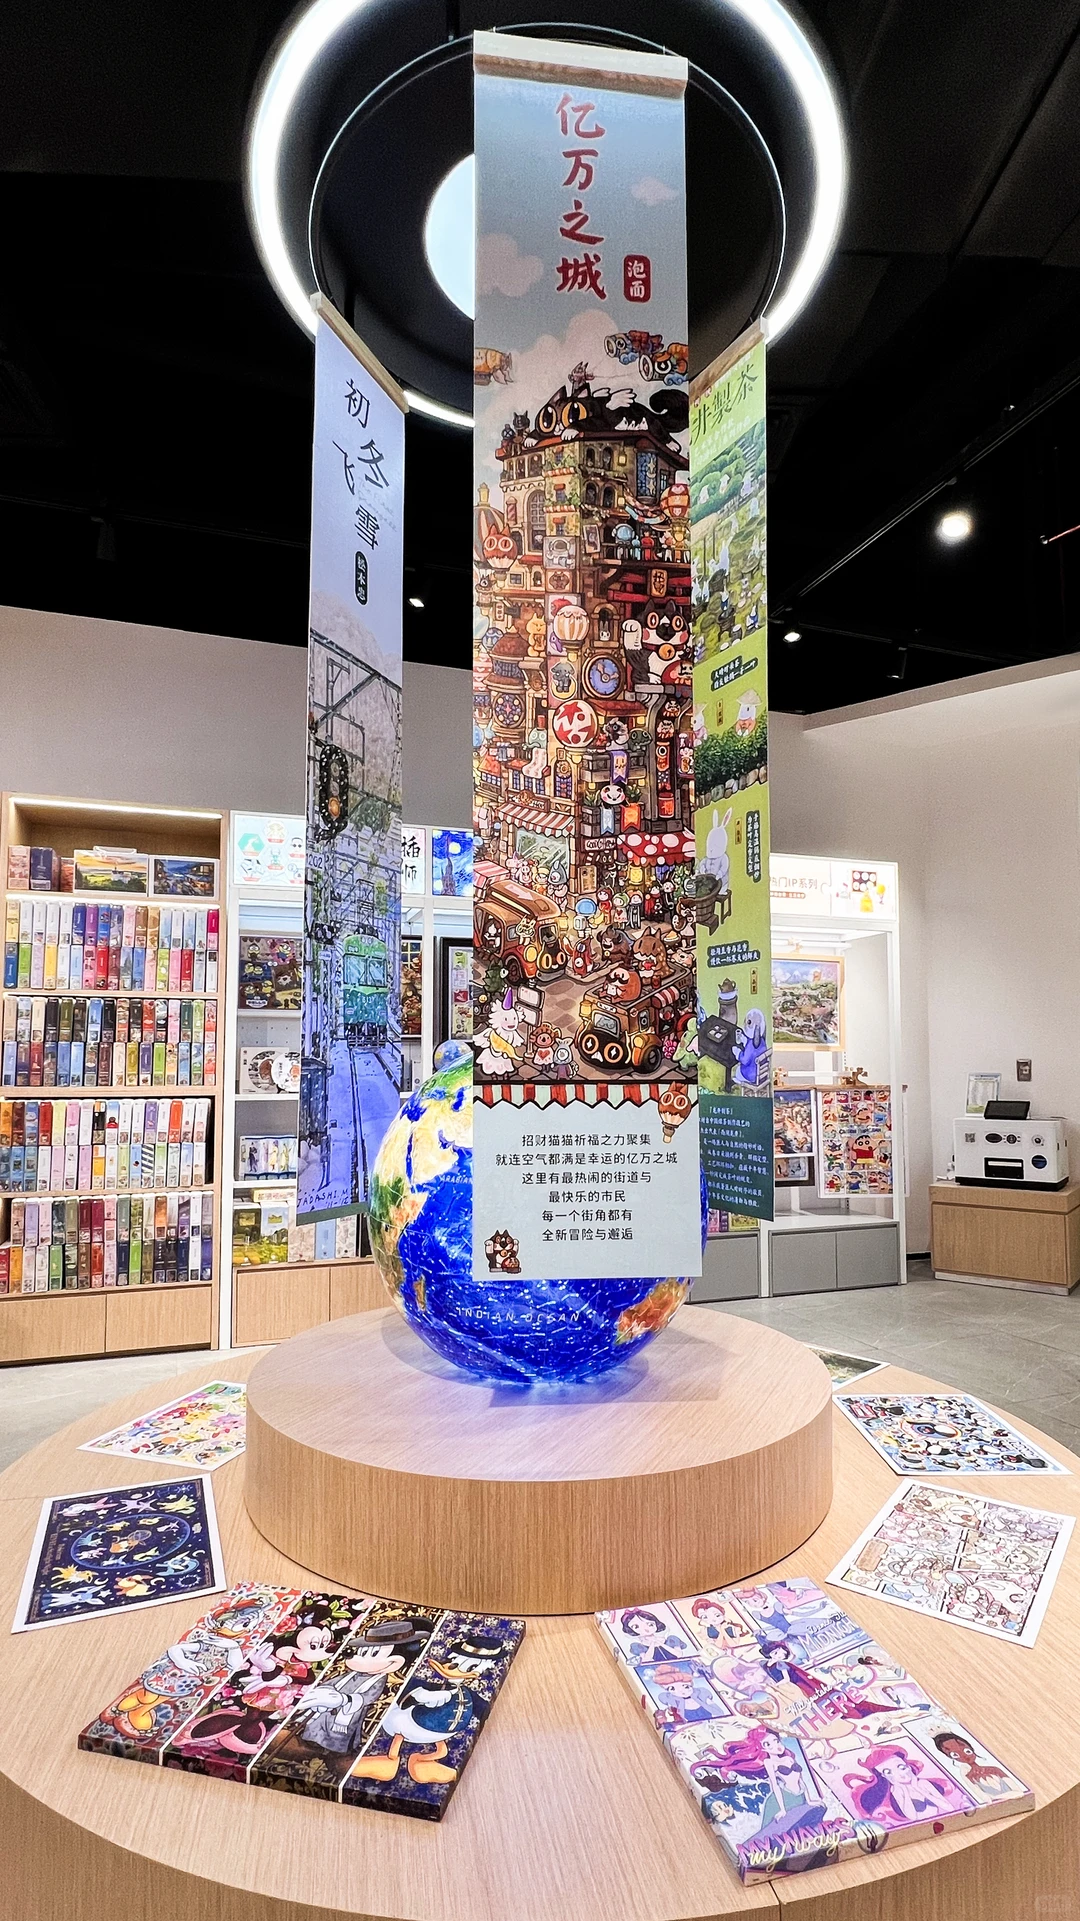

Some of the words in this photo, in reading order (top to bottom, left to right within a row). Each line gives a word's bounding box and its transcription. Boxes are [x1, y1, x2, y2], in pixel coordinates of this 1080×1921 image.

[555, 92, 607, 300] 亿万之城
[627, 259, 647, 299] 泡面
[521, 1133, 651, 1147] 招财猫猫祈福之力聚集
[495, 1152, 678, 1166] 就连空气都满是幸运的亿万之城
[521, 1171, 652, 1185] 这里有最热闹的街道与
[549, 1190, 626, 1203] 最快乐的市民
[542, 1209, 633, 1222] 每一个街角都有
[542, 1228, 633, 1242] 全新冒险与邂逅
[456, 1307, 514, 1321] INDIAN
[789, 1681, 868, 1738] THERE
[773, 1817, 857, 1856] WAVES
